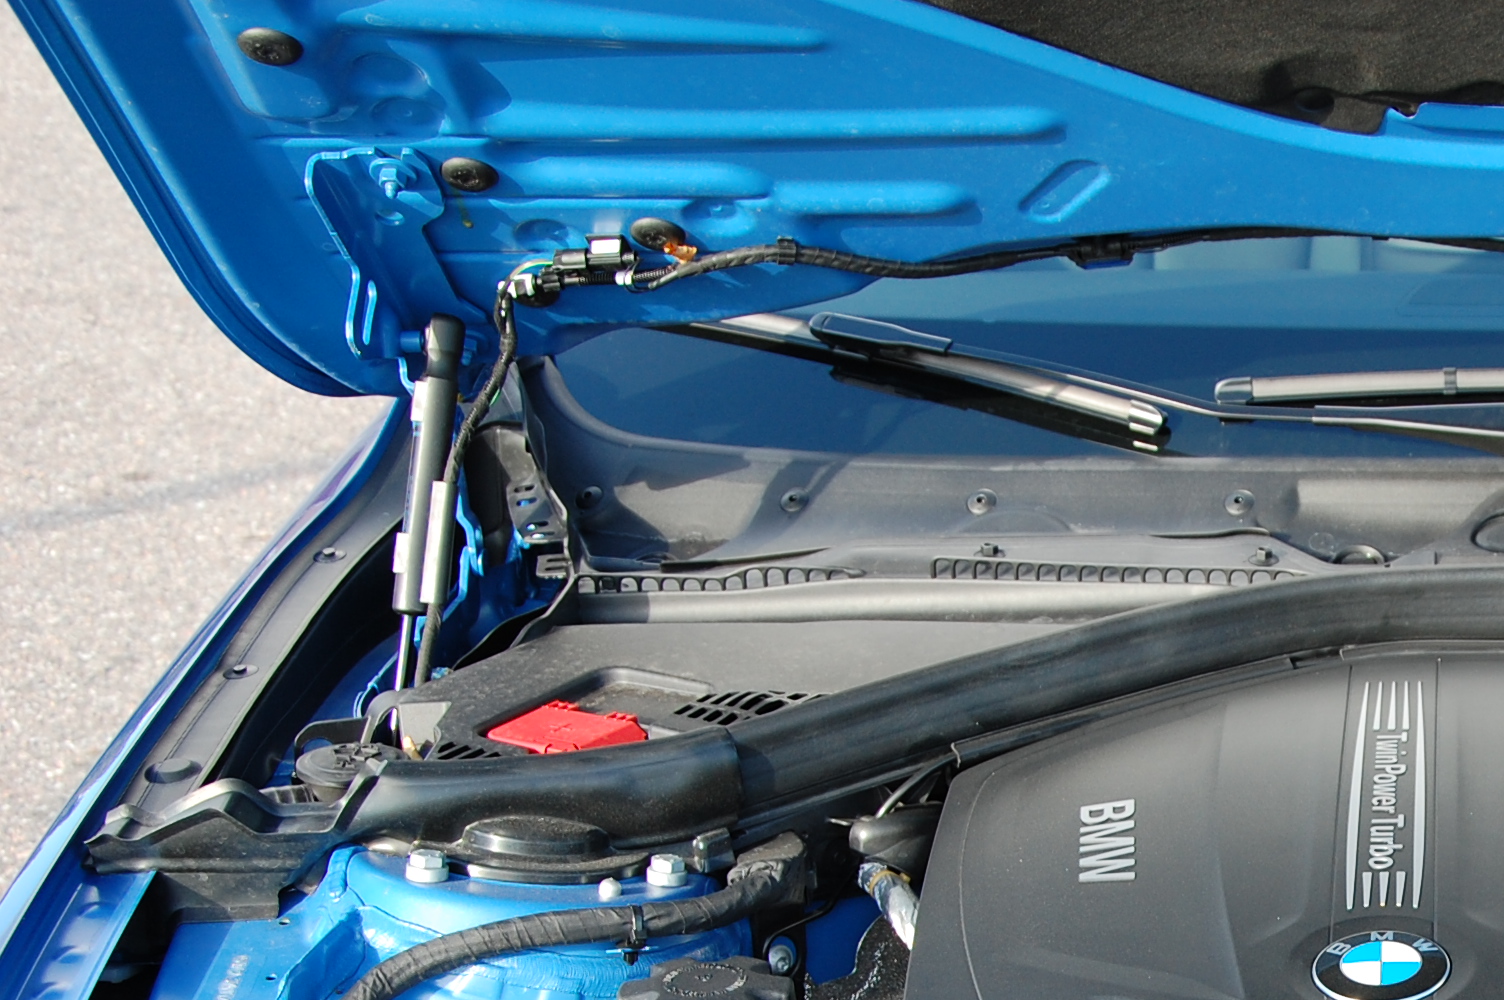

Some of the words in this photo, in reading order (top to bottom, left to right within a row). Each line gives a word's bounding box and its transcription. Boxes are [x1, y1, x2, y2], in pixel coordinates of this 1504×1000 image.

[1370, 731, 1408, 814] TwinPower
[1078, 798, 1136, 883] BMW
[1368, 813, 1405, 870] Turbo
[1326, 930, 1439, 956] BMW
